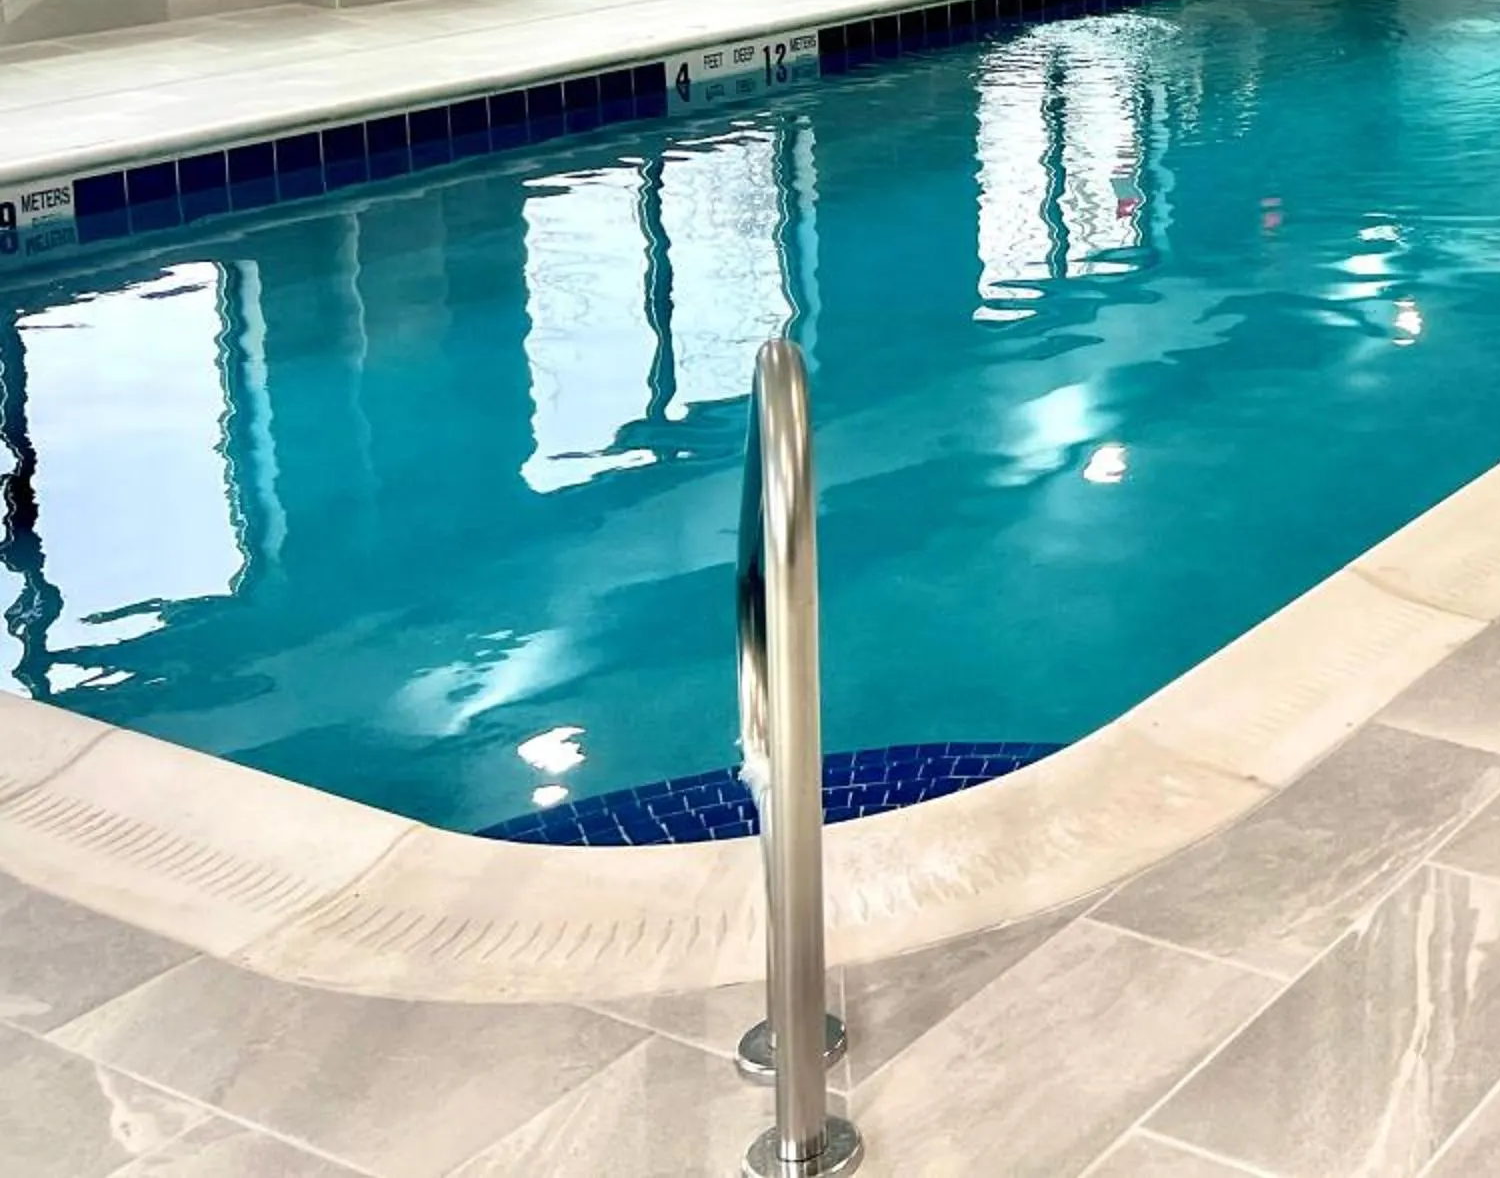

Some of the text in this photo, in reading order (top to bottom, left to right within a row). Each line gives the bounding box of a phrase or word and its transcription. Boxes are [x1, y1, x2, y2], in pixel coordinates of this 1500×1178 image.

[676, 62, 690, 86] 4
[703, 52, 724, 70] FEET
[733, 46, 755, 64] DEEP
[789, 35, 817, 52] METERS
[21, 186, 71, 214] METERS
